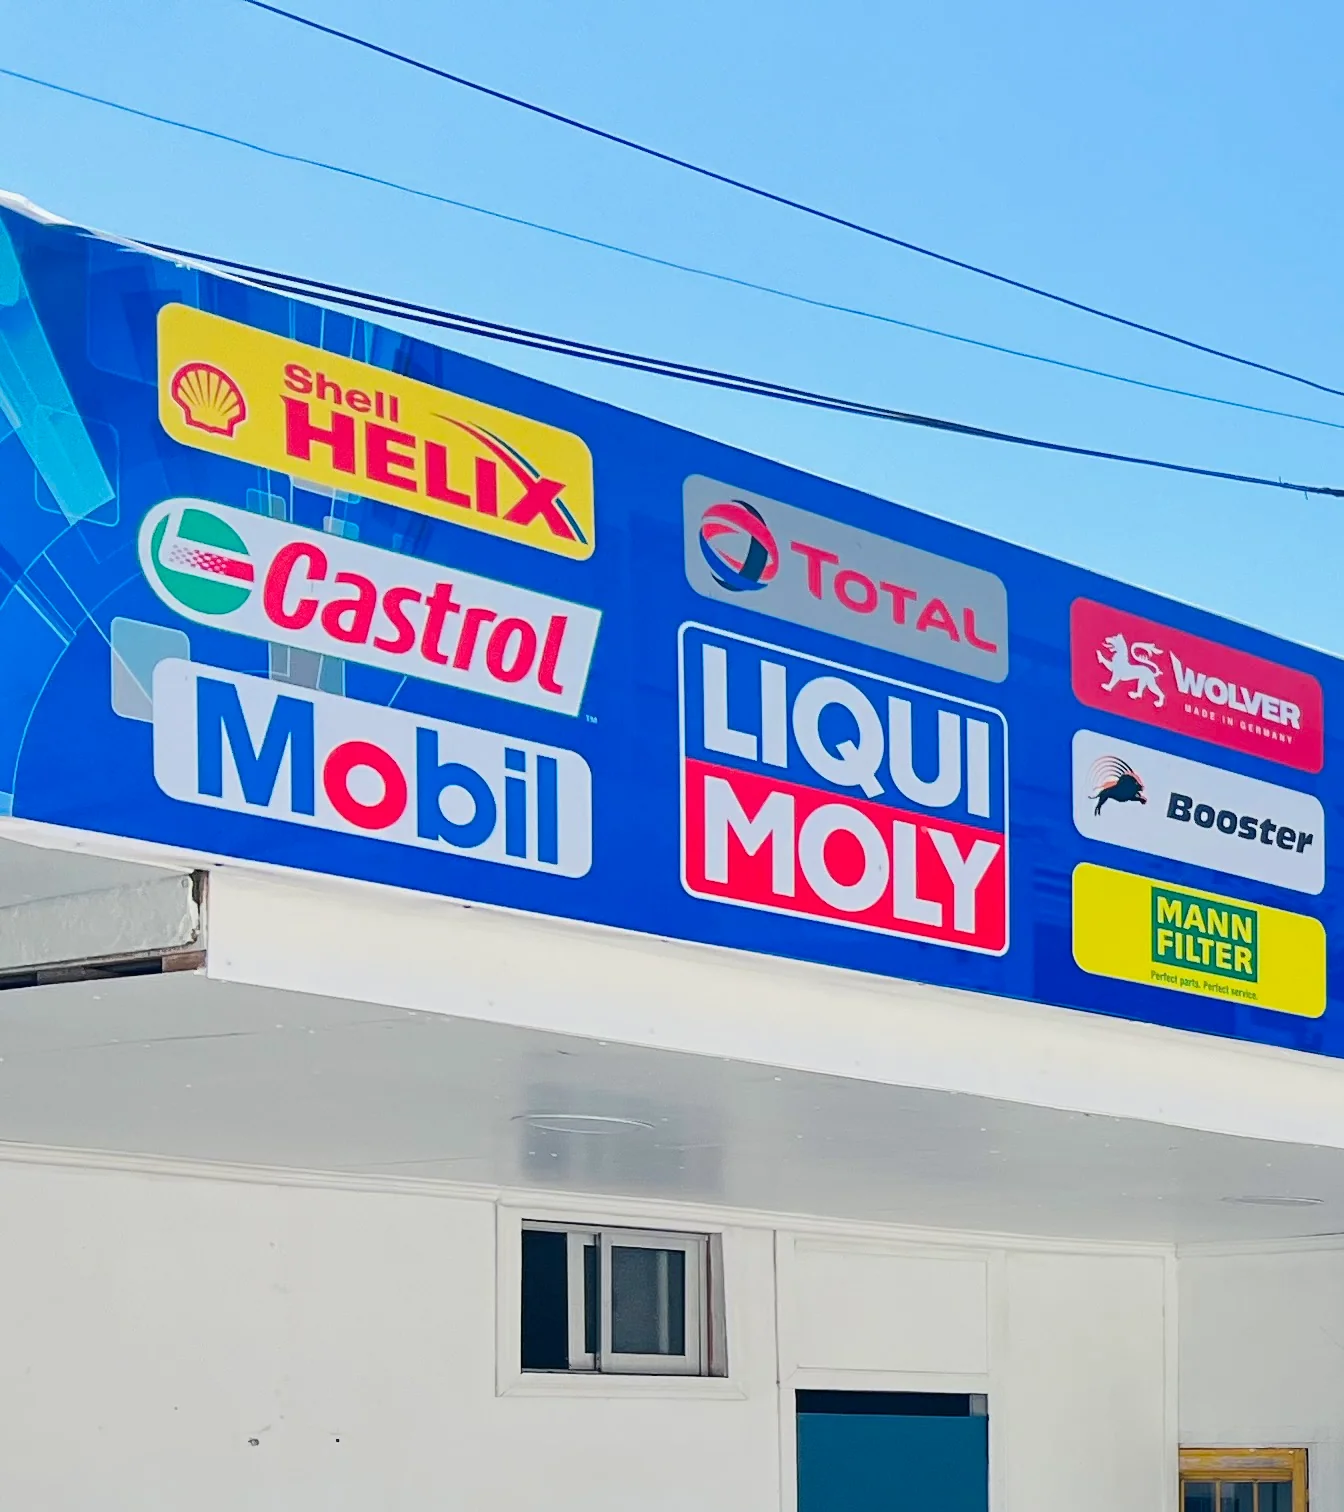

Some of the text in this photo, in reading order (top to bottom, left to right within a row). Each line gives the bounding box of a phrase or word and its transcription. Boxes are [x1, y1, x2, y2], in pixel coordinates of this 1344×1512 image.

[283, 363, 399, 422] Shell
[280, 395, 580, 540] HELIX
[262, 541, 567, 694] Castrol
[790, 541, 998, 654] TOTAL
[1169, 650, 1301, 730] WOLVER
[1184, 703, 1293, 744] MADE IN GERMANY
[196, 676, 559, 865] Mobil
[702, 643, 990, 818] LIQUI
[704, 775, 1000, 934] MOLY
[1167, 792, 1313, 853] Booster
[1157, 896, 1252, 944] MANN
[1157, 928, 1253, 974] FILTER
[1151, 969, 1177, 984] Perfect
[1204, 980, 1229, 995] Perfect
